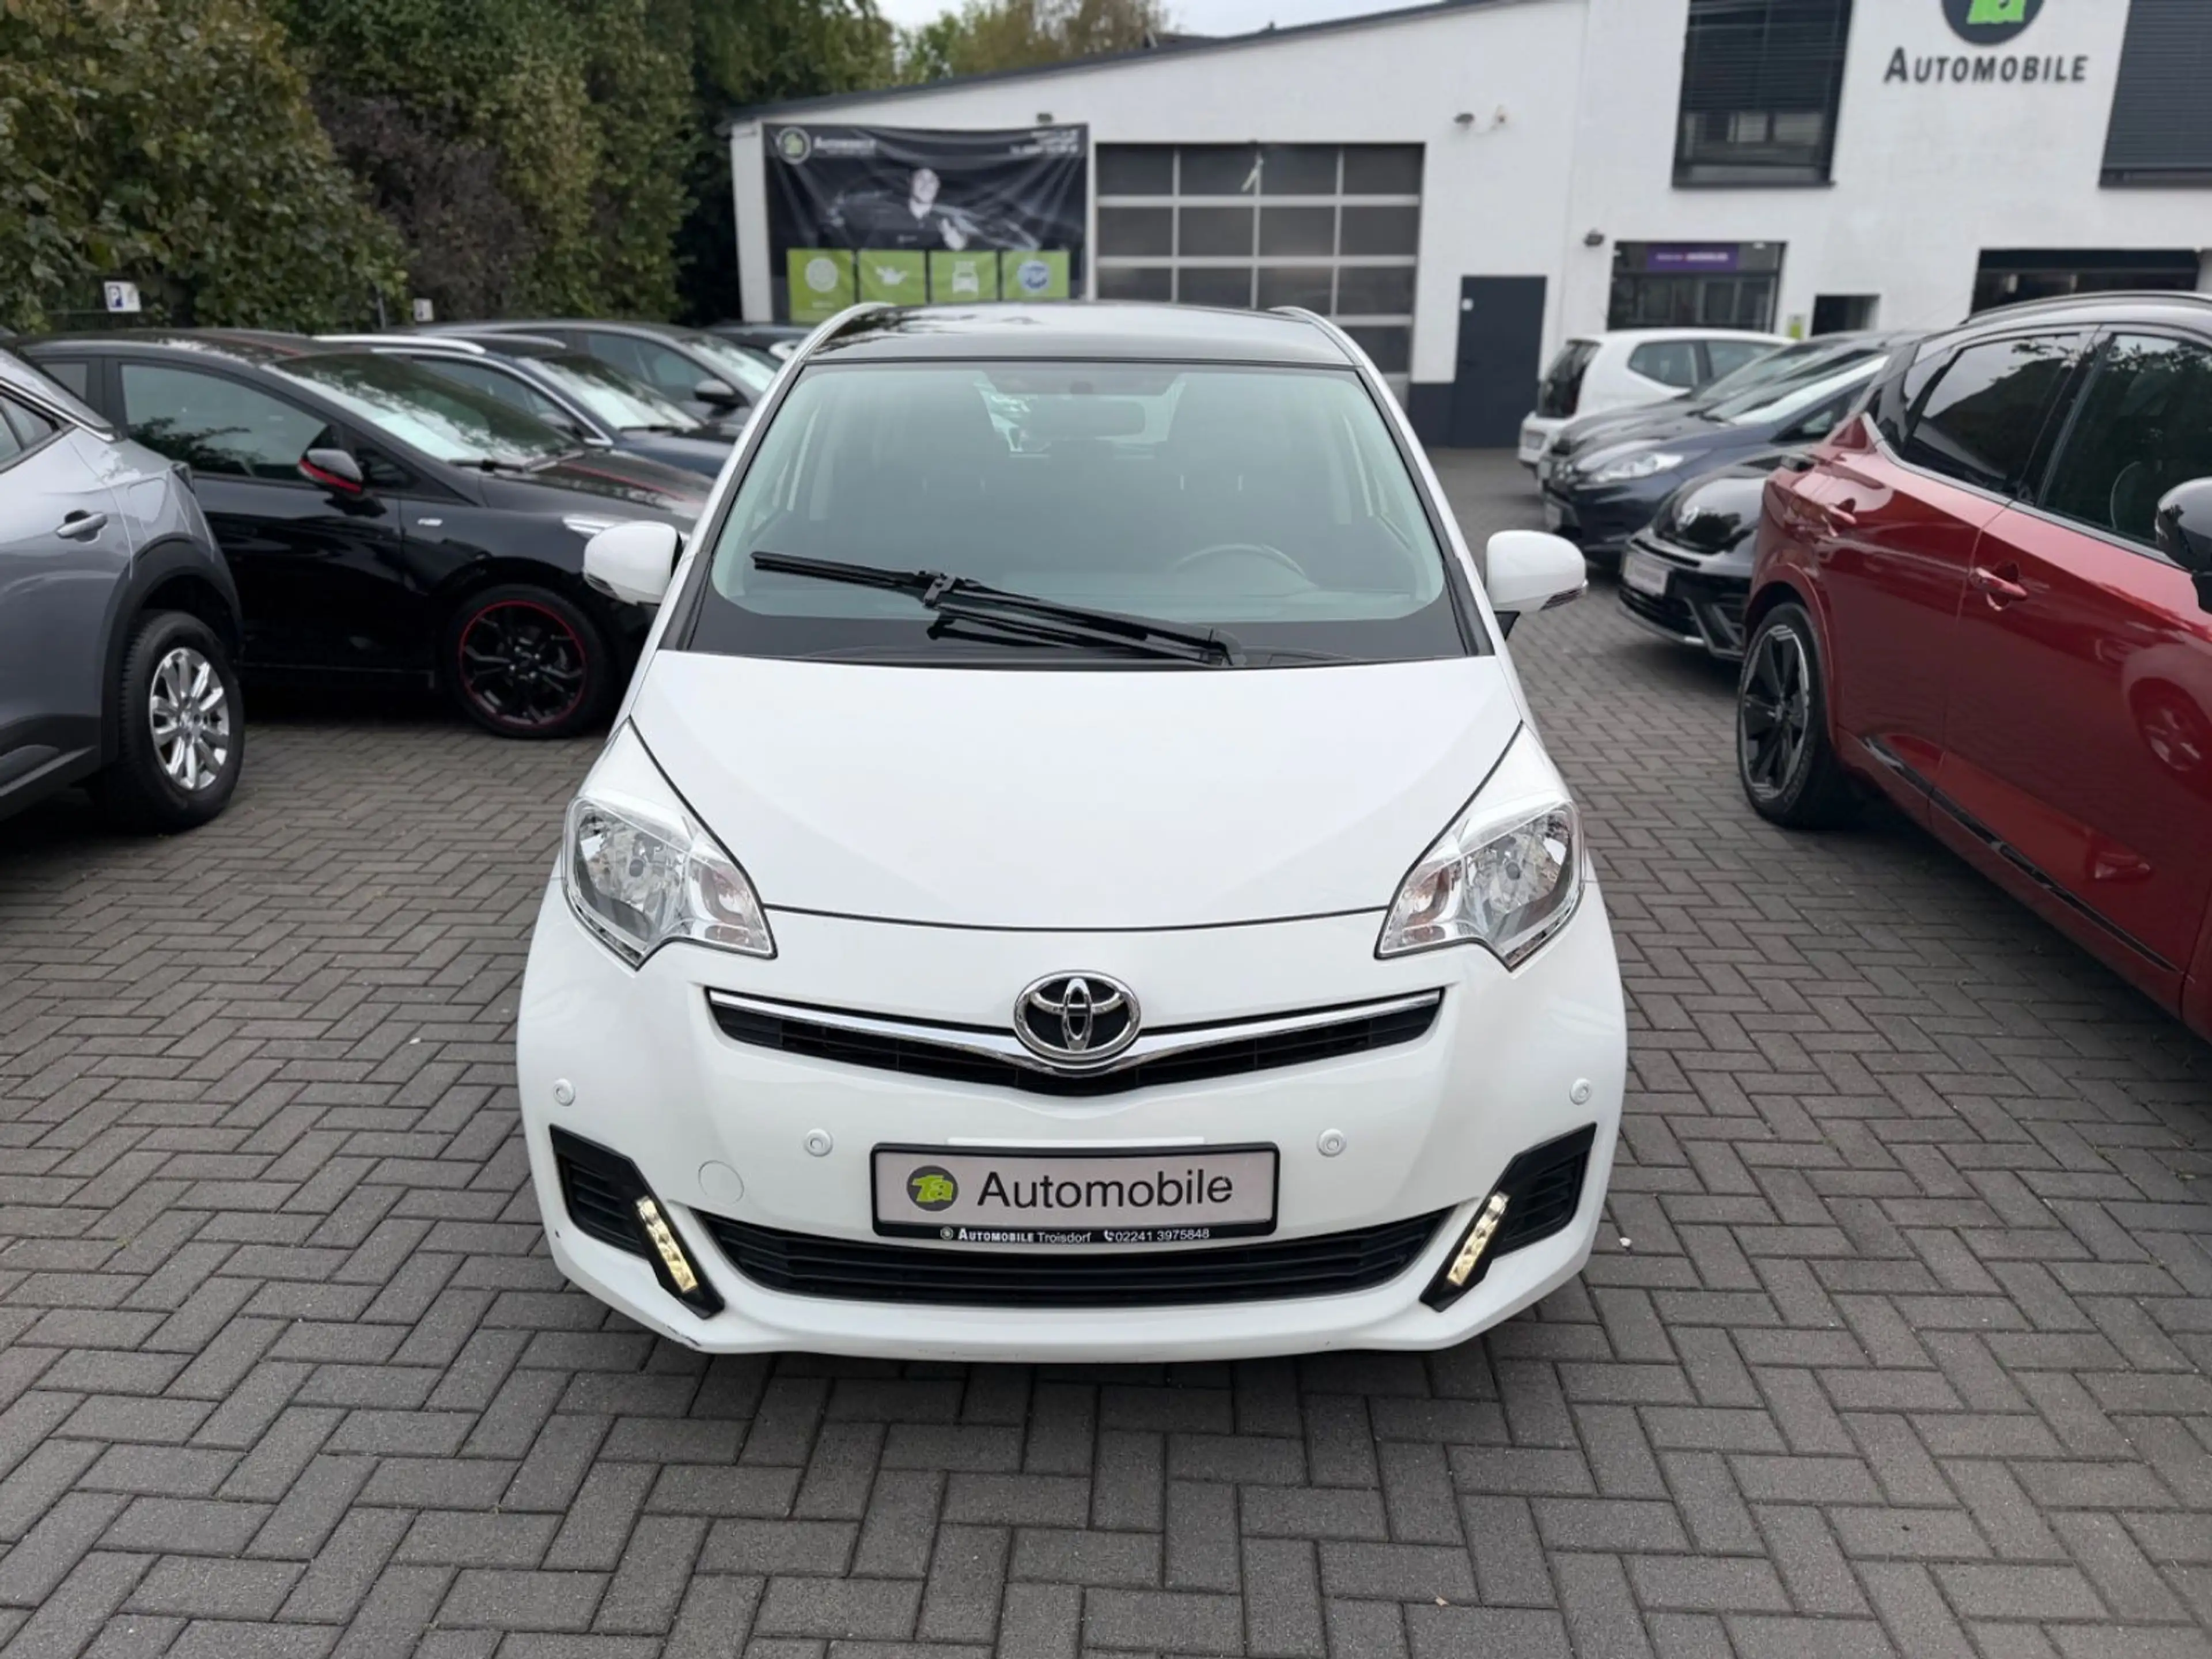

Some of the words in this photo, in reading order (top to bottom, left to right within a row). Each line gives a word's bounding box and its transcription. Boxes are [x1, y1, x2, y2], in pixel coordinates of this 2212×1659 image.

[1884, 46, 2089, 84] AUTOMOBILE
[977, 1169, 1233, 1209] Automobile
[958, 1227, 1035, 1243] AUTOMOBILE
[1037, 1231, 1092, 1244] Troisdorf
[1115, 1230, 1153, 1243] 02241
[1157, 1228, 1210, 1242] 3975848
